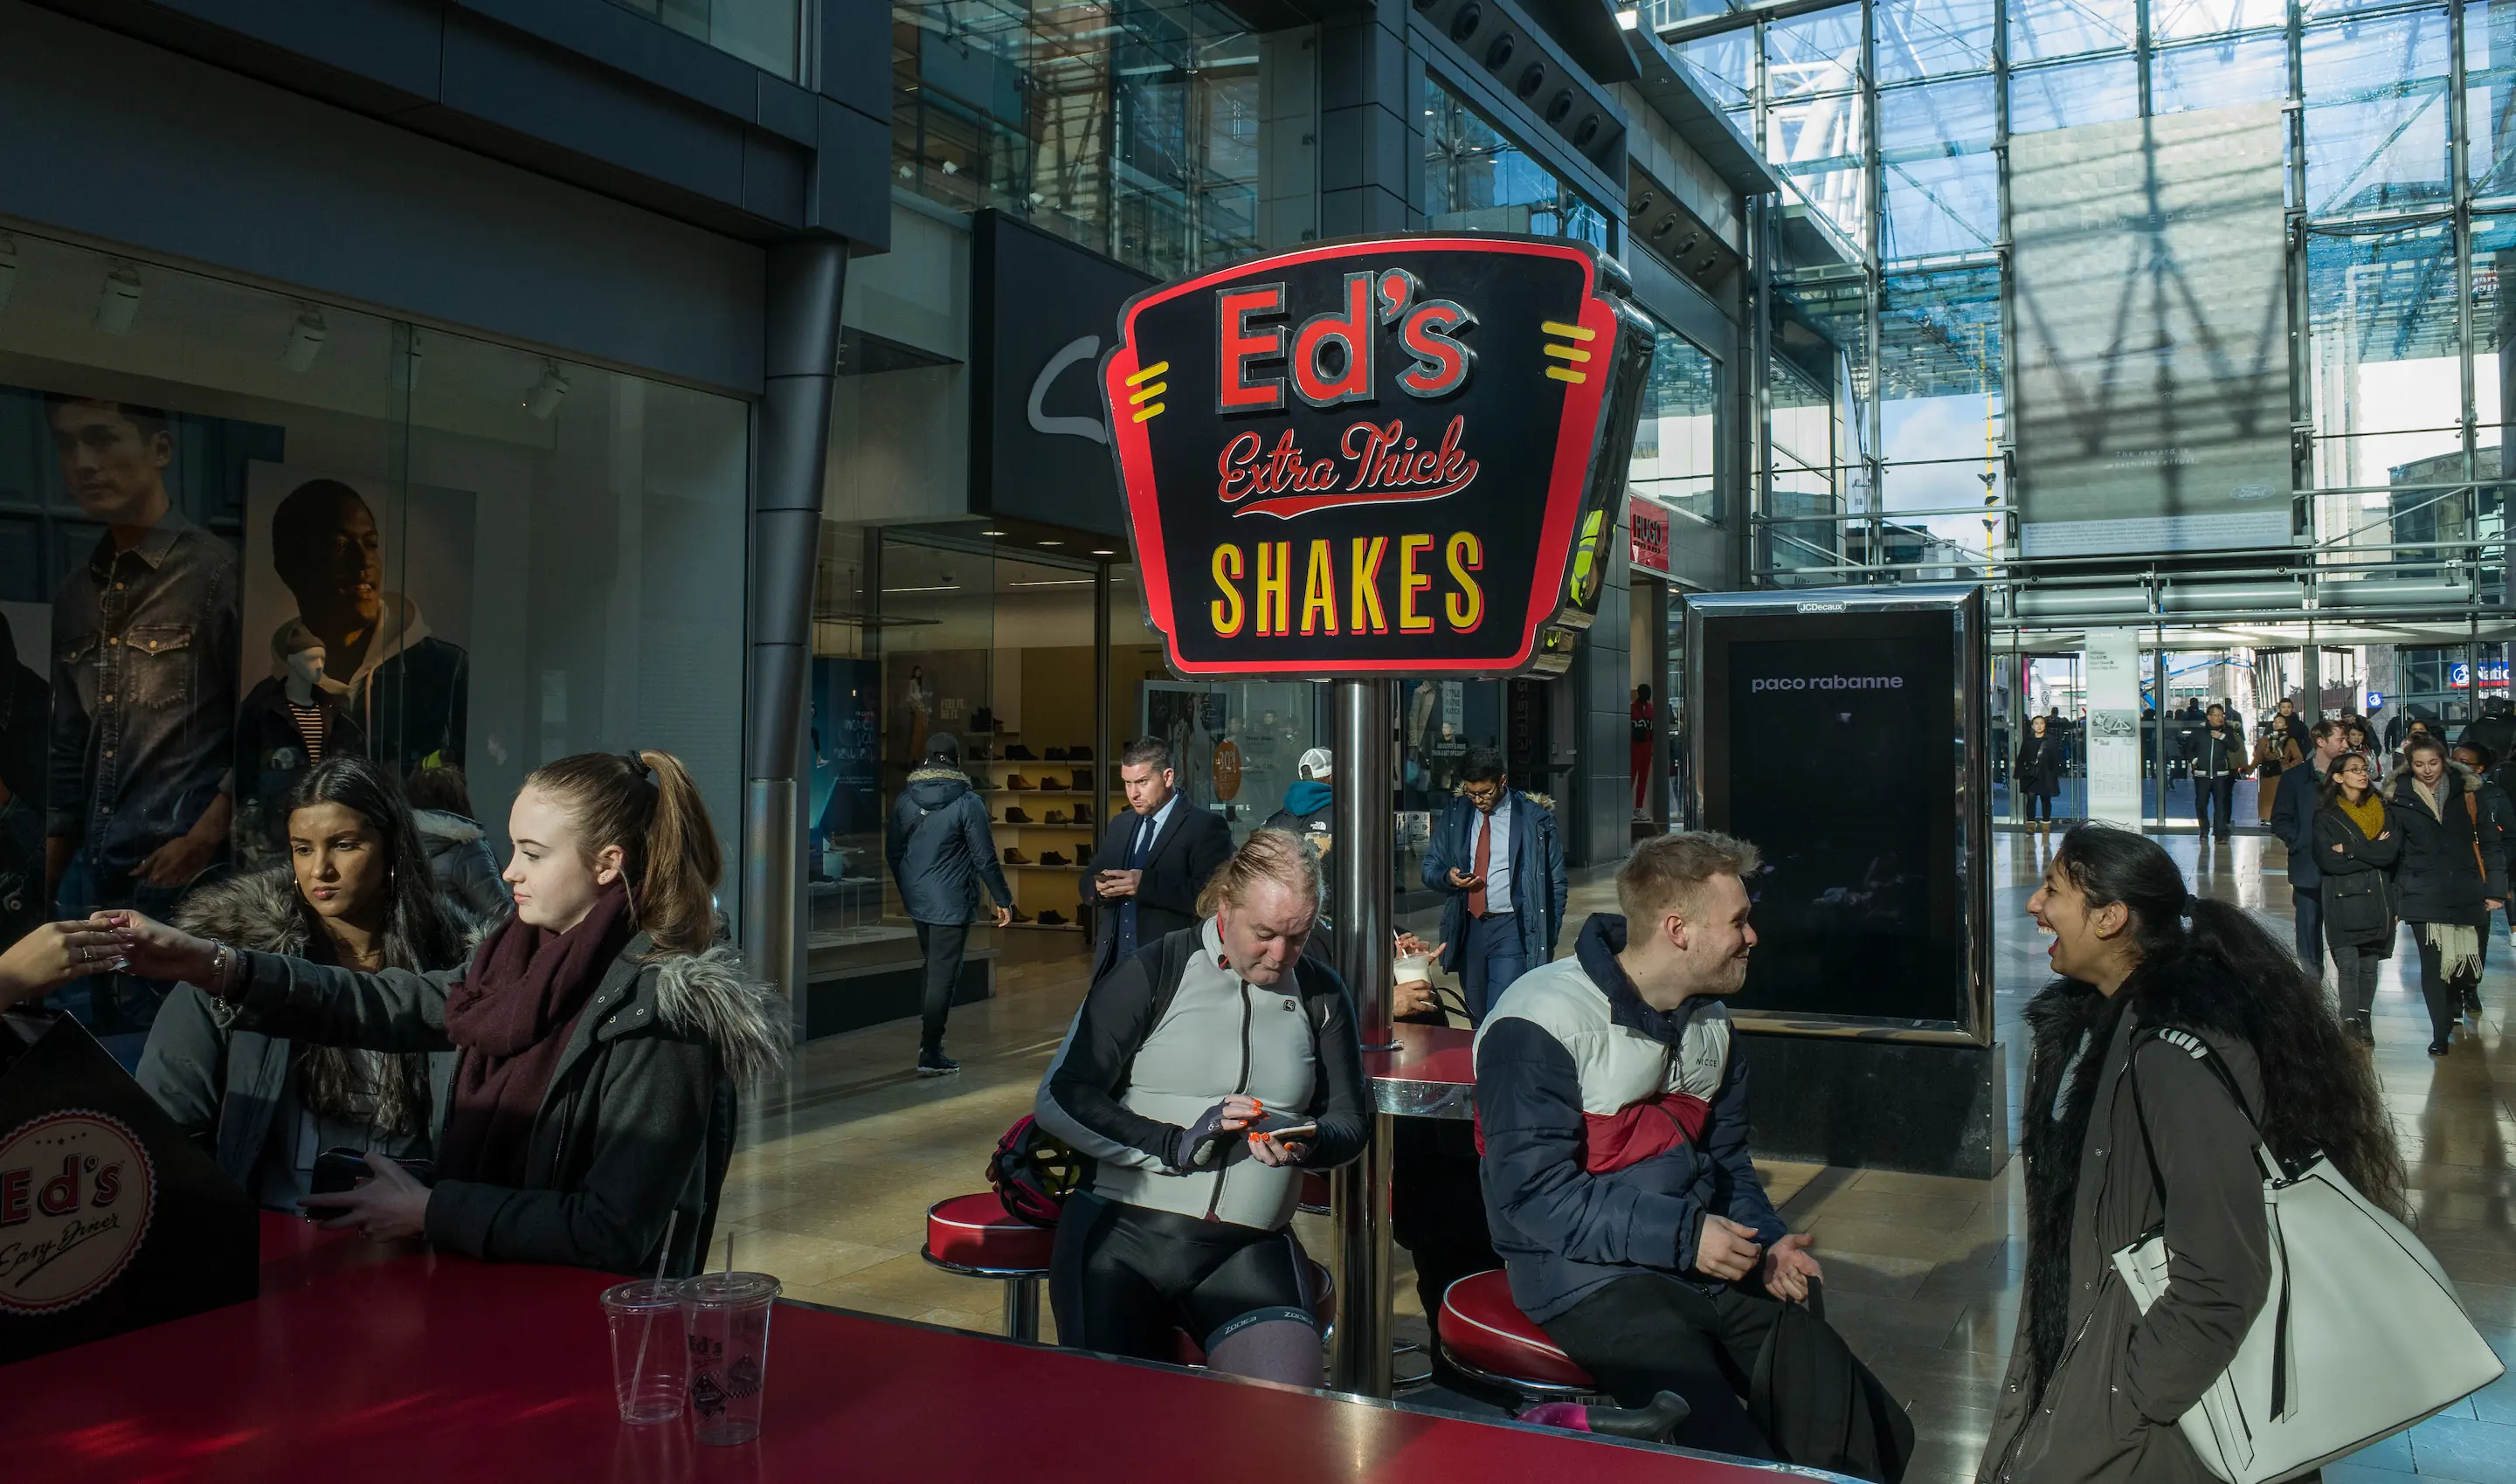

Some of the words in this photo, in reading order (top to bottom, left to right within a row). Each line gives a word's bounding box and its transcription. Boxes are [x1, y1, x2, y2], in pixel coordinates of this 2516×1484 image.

[1215, 267, 1478, 414] Ed's
[1218, 430, 1340, 503] Extra
[1339, 414, 1480, 494] Thick
[2141, 459, 2159, 467] the
[2238, 486, 2267, 498] Ford
[1633, 514, 1662, 546] HUGO
[1211, 531, 1484, 638] SHAKES
[1800, 603, 1842, 611] JCDecaux
[2127, 632, 2135, 642] 2
[1752, 677, 1806, 693] paco
[1809, 674, 1904, 690] rabanne
[1696, 1059, 1718, 1067] NICCE
[0, 1152, 123, 1228] Ed's
[0, 1240, 57, 1277] Easy
[58, 1213, 121, 1252] Diner
